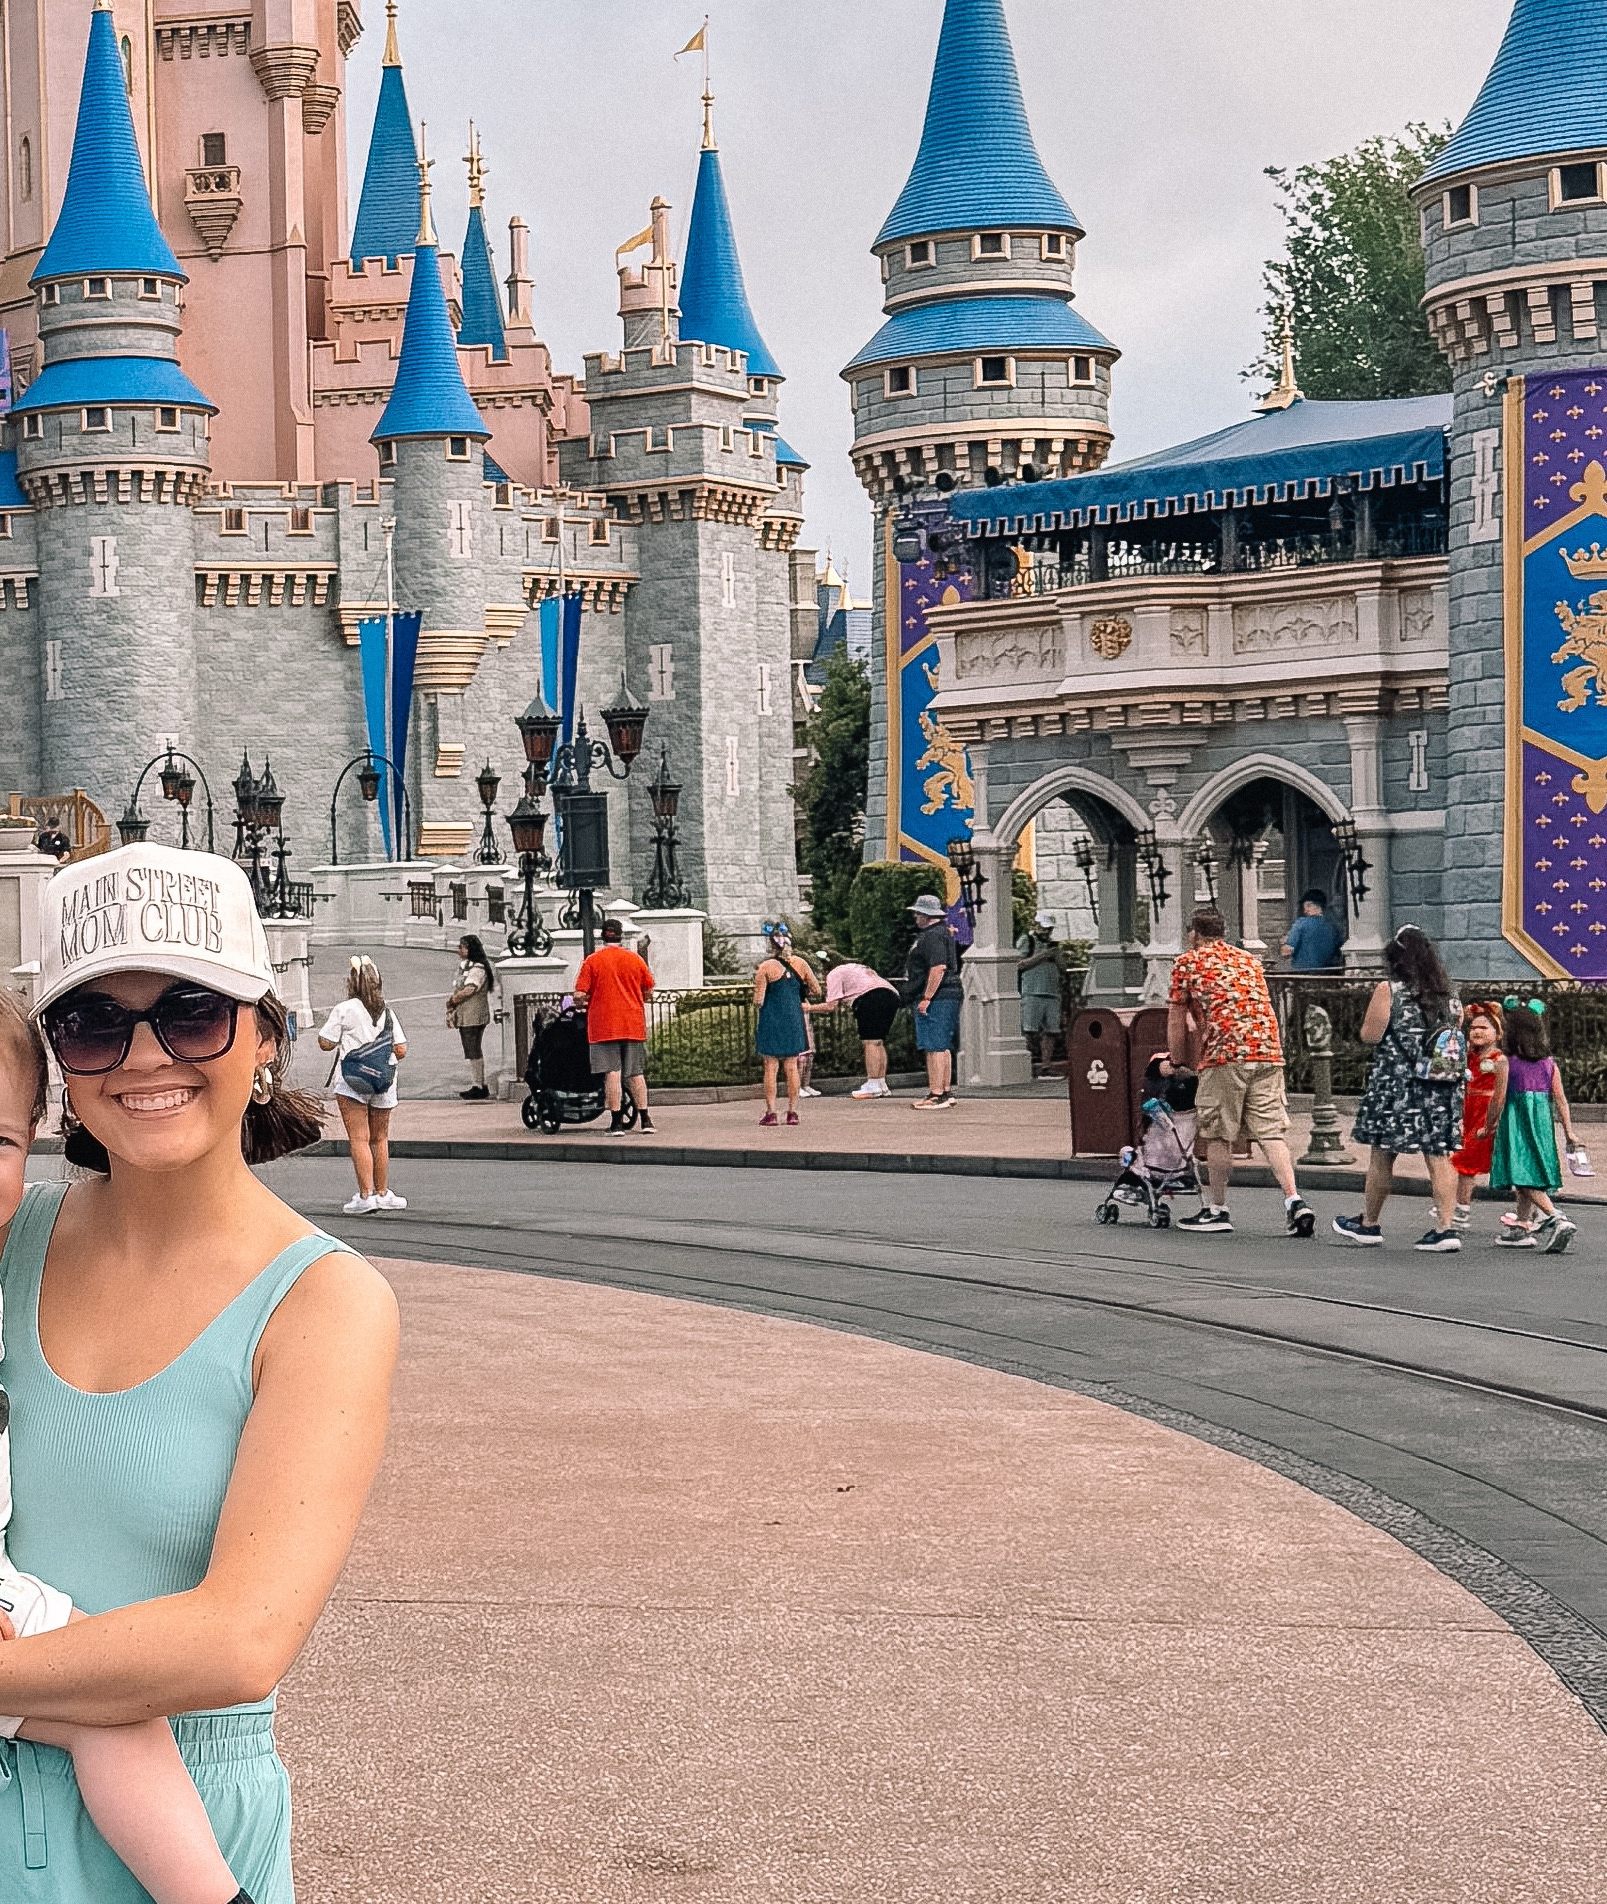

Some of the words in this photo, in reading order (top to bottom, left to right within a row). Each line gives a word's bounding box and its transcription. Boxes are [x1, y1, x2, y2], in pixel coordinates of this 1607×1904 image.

[62, 871, 119, 927] MAIN
[125, 867, 221, 912] STREET
[60, 902, 128, 969] MOM
[140, 901, 223, 953] CLUB
